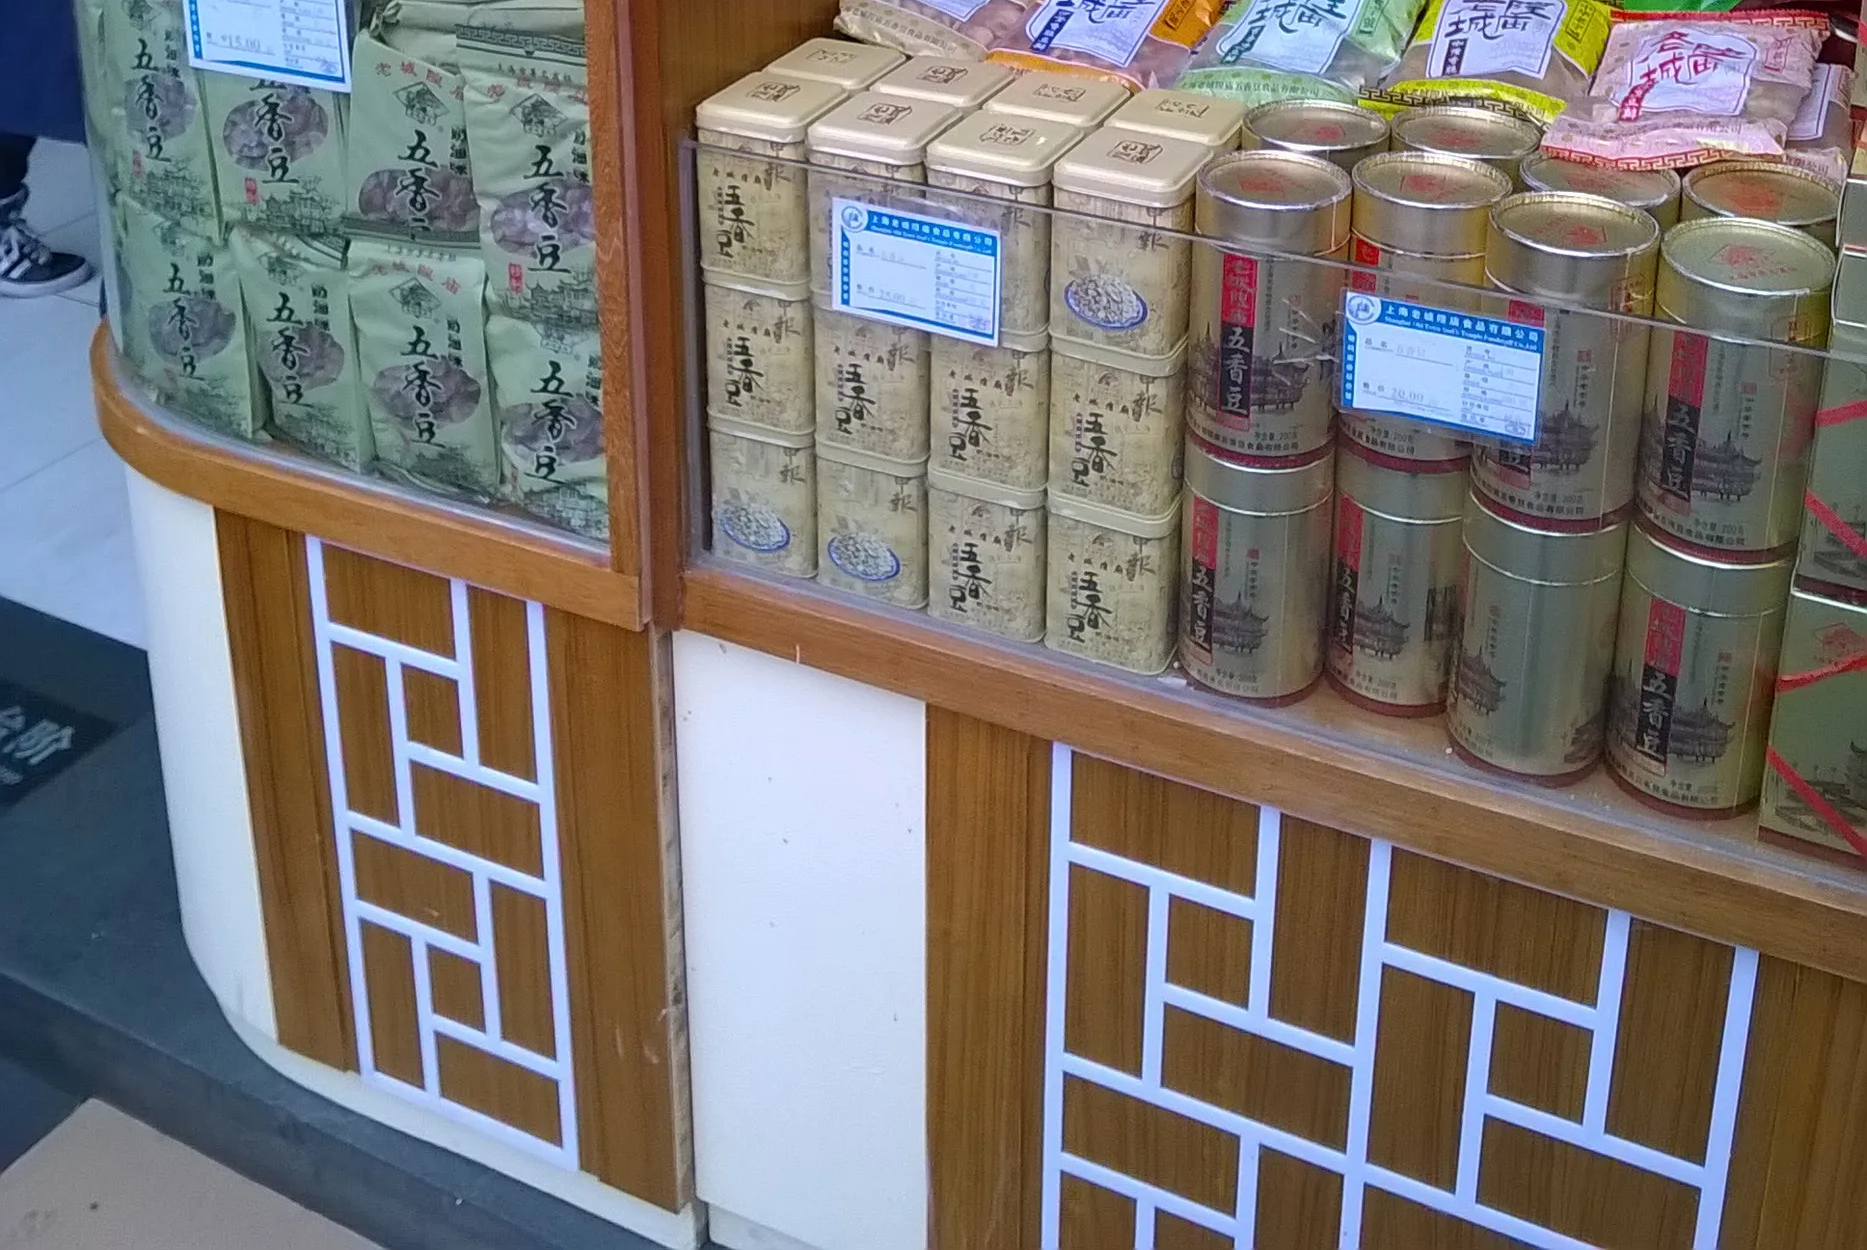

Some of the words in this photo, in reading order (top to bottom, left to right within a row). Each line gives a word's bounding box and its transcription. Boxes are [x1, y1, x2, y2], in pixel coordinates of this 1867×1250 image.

[131, 38, 171, 163] 五香豆
[523, 144, 572, 274] 五香豆
[163, 262, 206, 380] 五香豆
[266, 292, 315, 408] 五香豆
[1222, 327, 1252, 415] 五香豆
[400, 325, 446, 448] 五香豆
[524, 360, 577, 486] 五香豆
